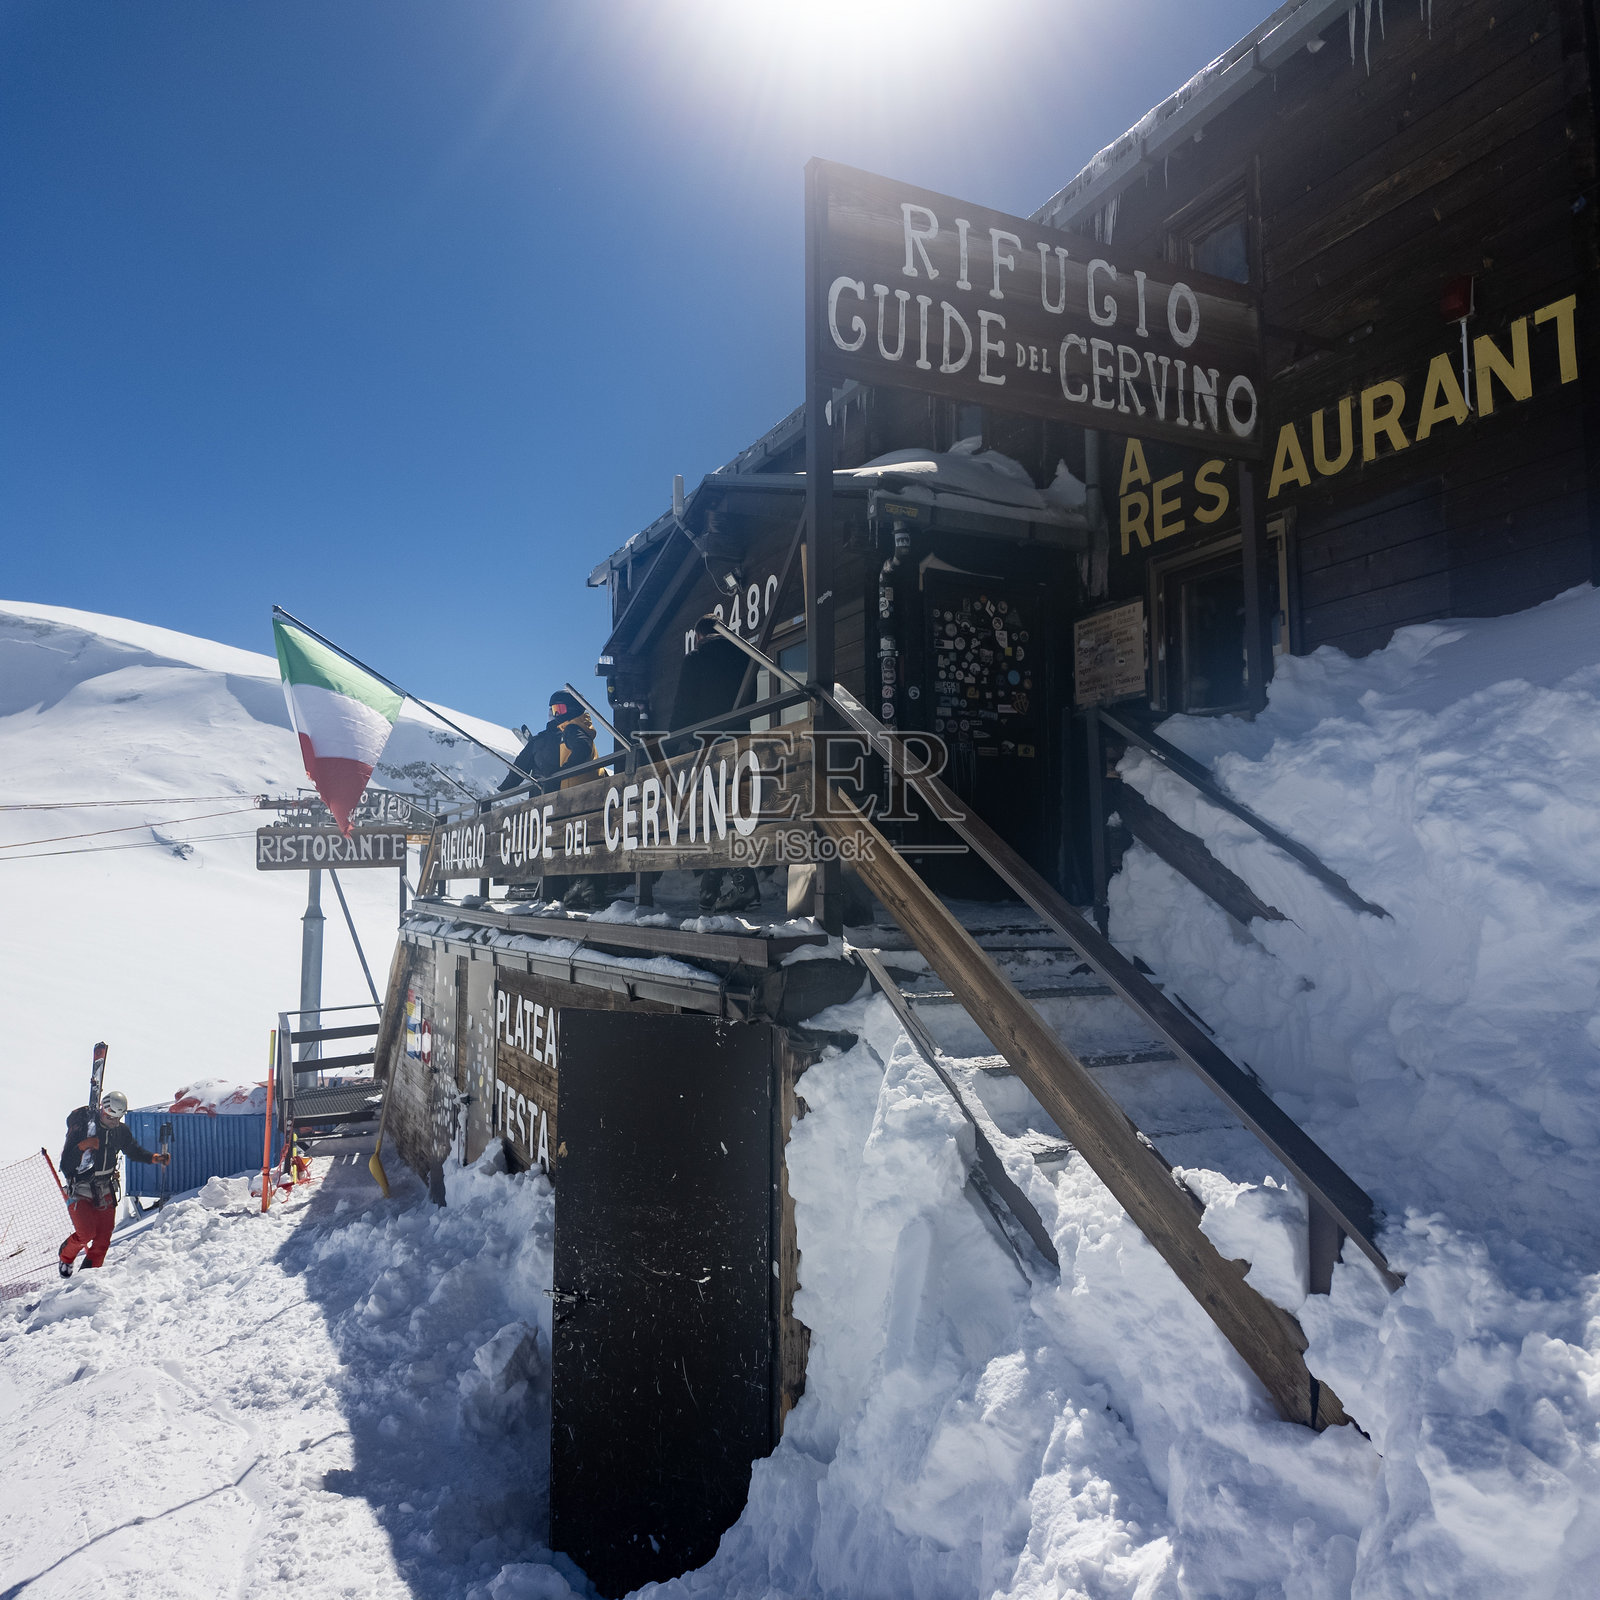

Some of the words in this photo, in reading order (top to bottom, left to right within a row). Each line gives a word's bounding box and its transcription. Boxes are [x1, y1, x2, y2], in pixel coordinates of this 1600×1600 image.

[900, 202, 1200, 349] RIFUGIO
[827, 276, 1007, 385] GUIDE
[1016, 342, 1052, 375] DEL
[1059, 333, 1258, 438] CERVINO
[258, 834, 405, 863] RISTORANTE
[440, 823, 486, 870] RIFUGIO
[500, 805, 554, 867] GUIDE
[564, 820, 590, 856] DEL
[604, 750, 762, 851] CERVINO
[496, 989, 561, 1069] PLATEA
[495, 1078, 550, 1174] TESTA
